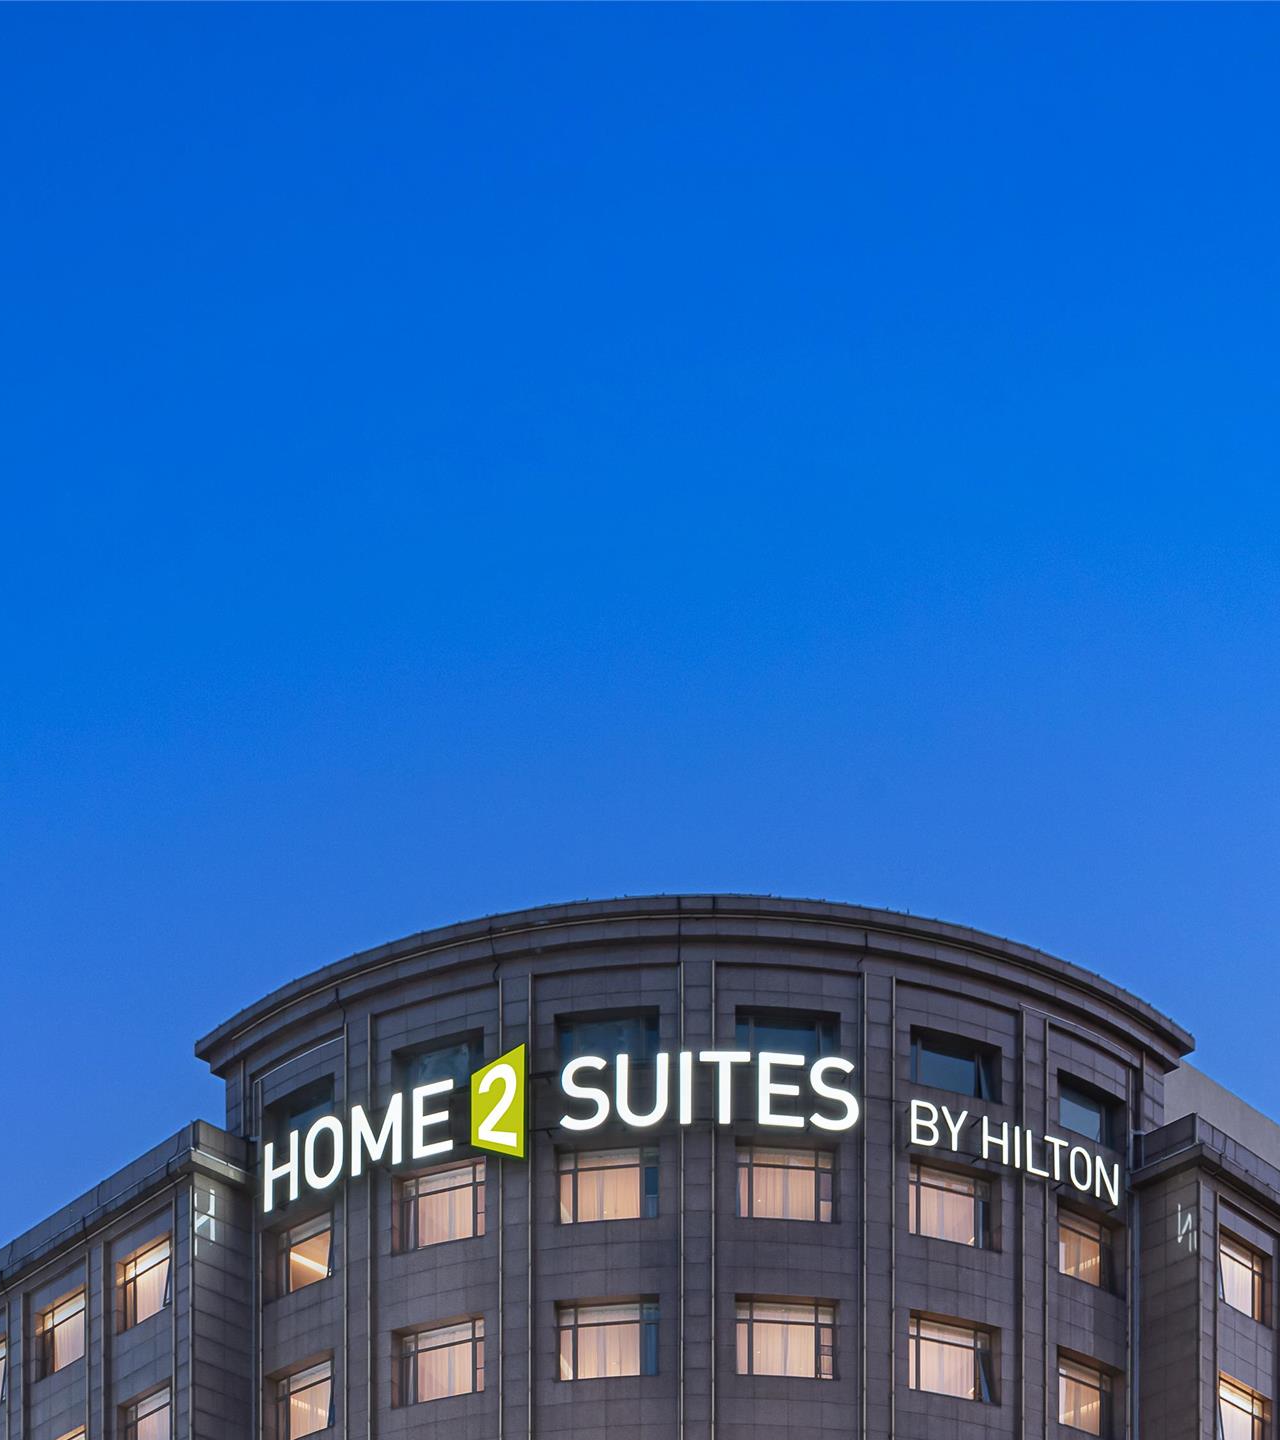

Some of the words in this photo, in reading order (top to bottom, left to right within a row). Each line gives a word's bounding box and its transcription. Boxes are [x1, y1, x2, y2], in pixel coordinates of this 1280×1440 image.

[263, 1078, 454, 1213] HOME
[478, 1061, 518, 1148] 2
[559, 1049, 861, 1131] SUITES
[909, 1098, 969, 1152] BY
[982, 1114, 1120, 1207] HILTON
